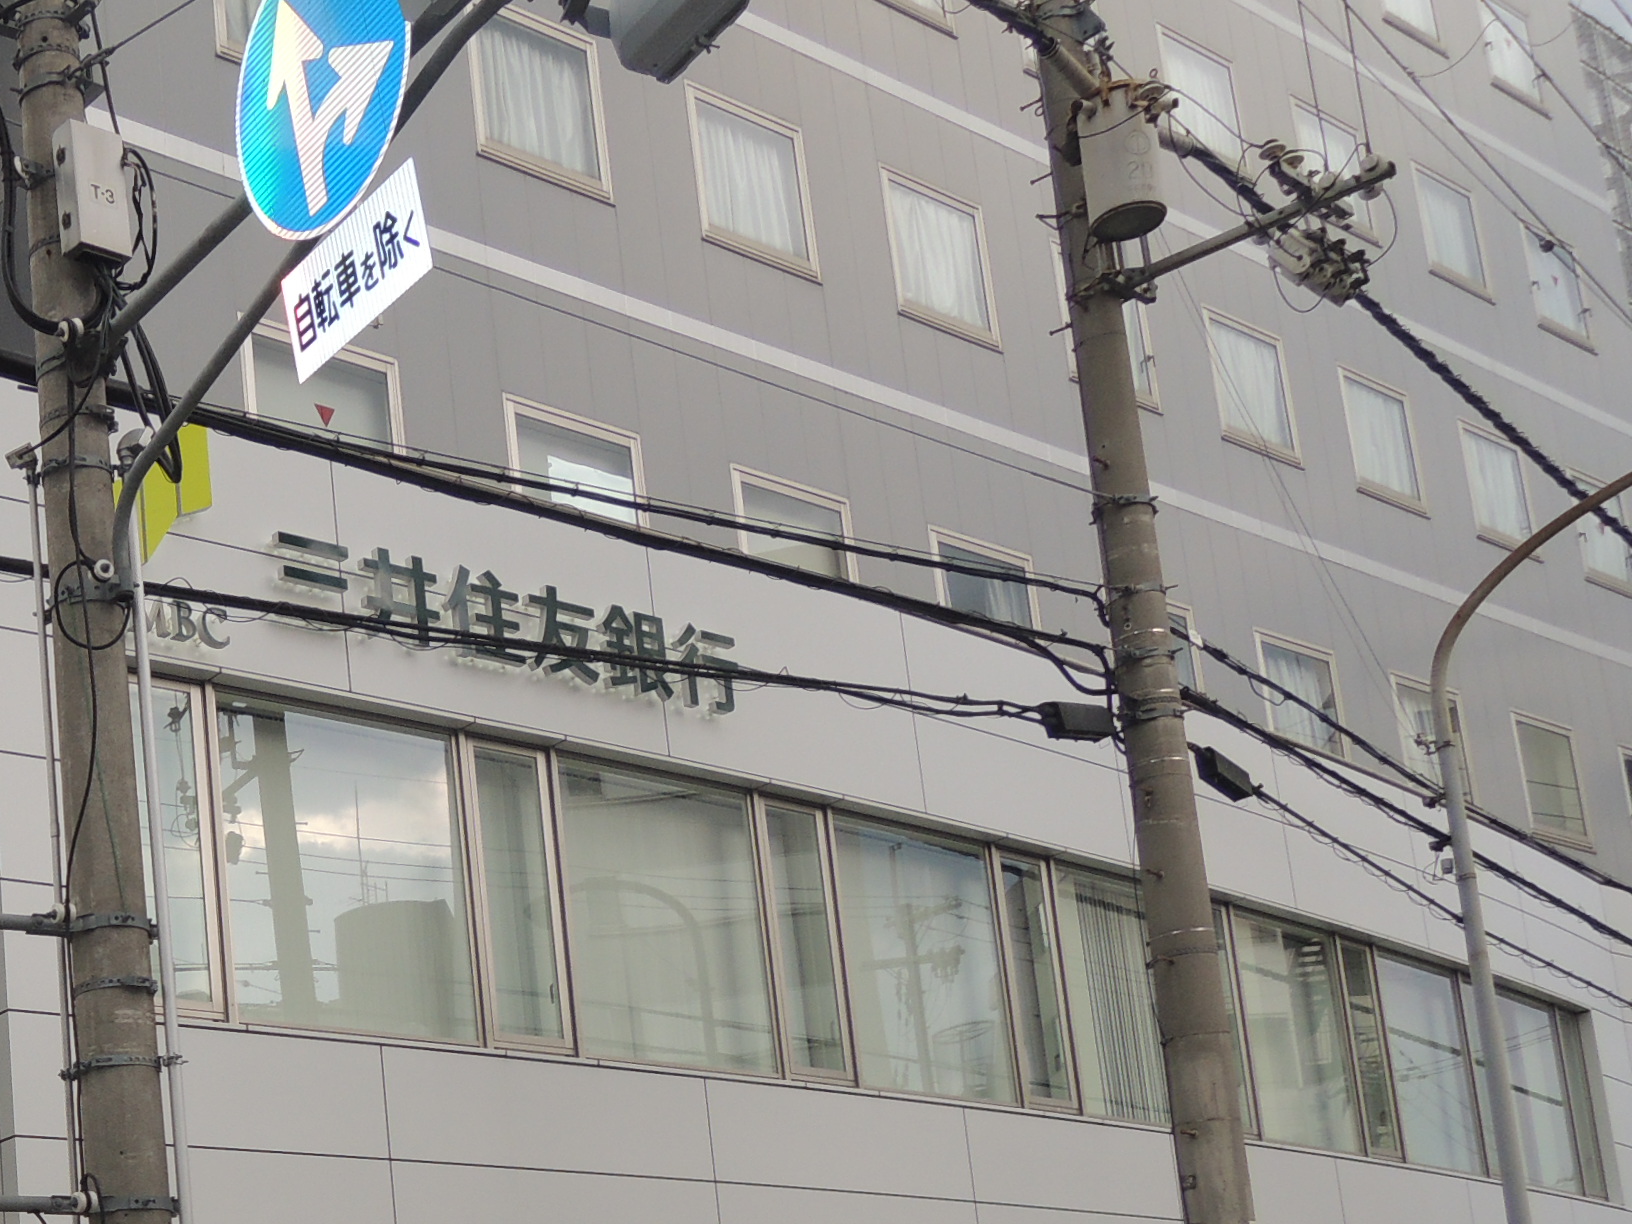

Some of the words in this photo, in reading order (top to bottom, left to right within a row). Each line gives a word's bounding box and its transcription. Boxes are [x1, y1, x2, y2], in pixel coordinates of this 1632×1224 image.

[293, 209, 421, 353] 自転車を除く
[128, 597, 231, 650] MBC
[272, 531, 739, 715] 三井住友銀行
